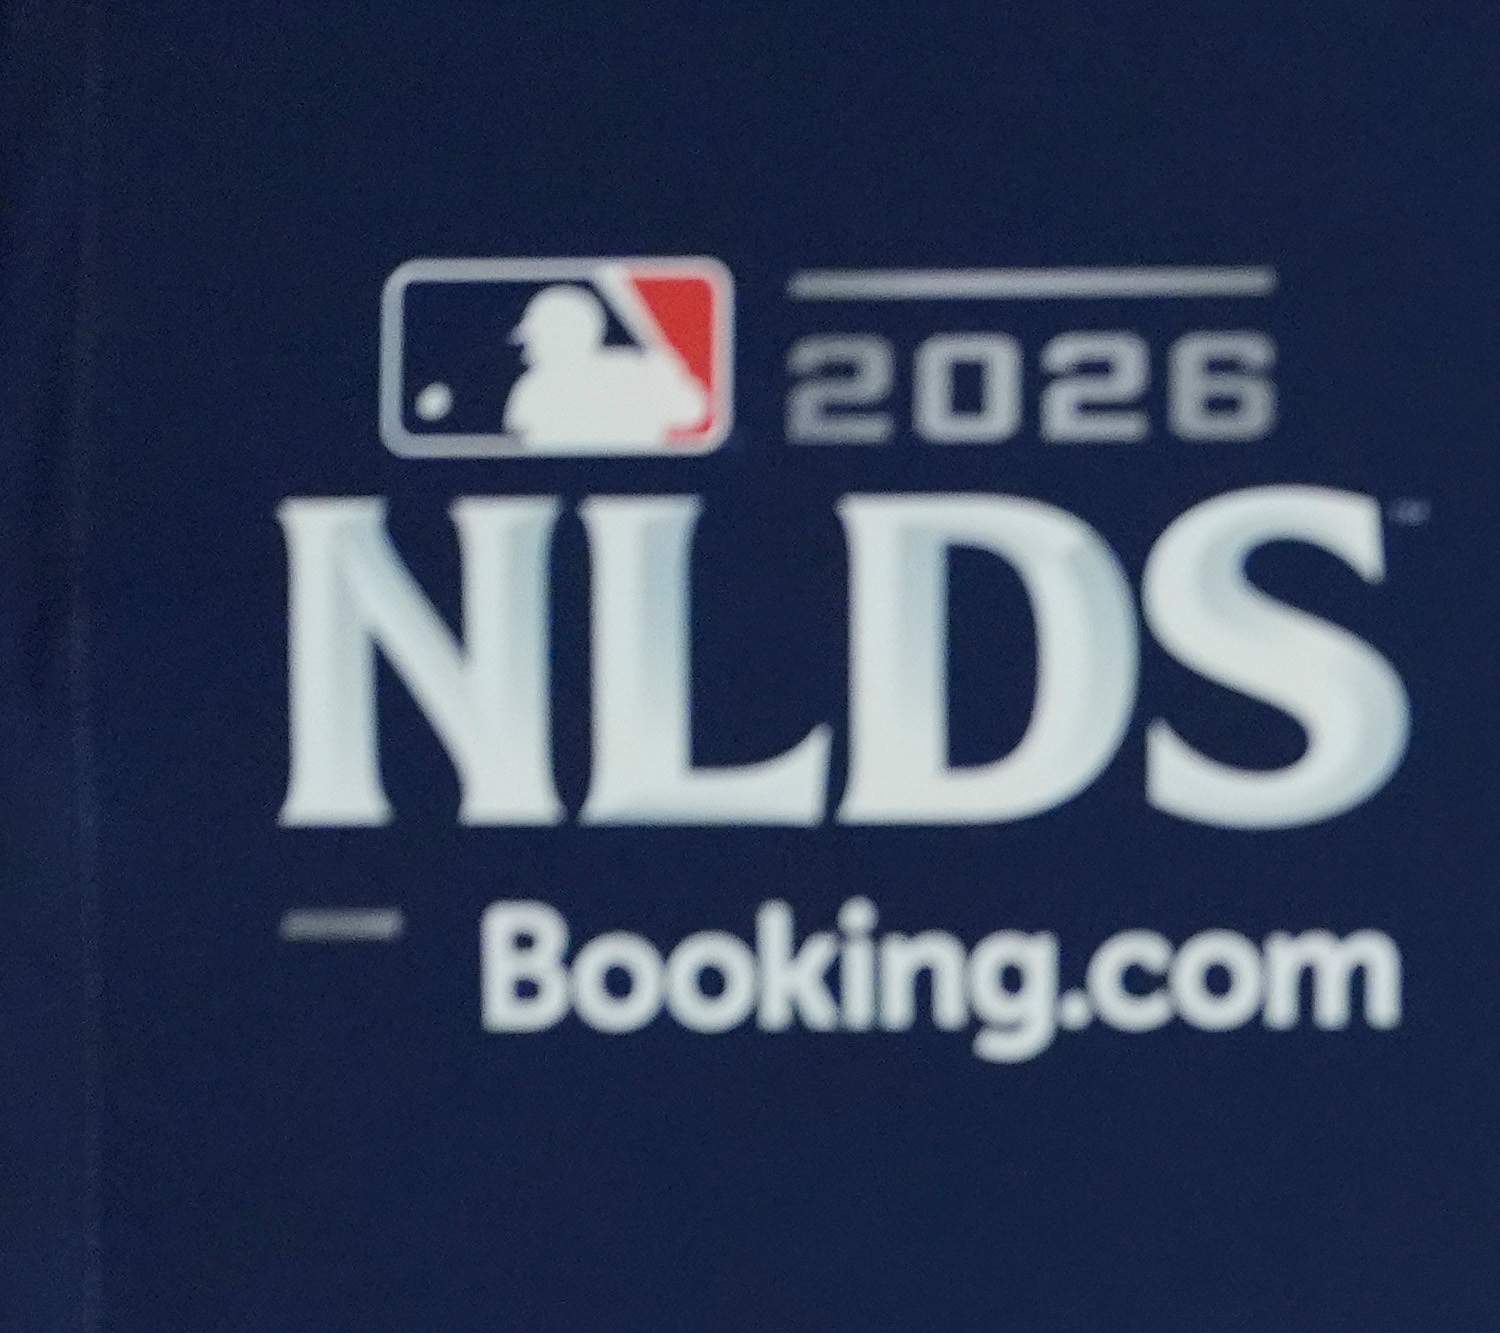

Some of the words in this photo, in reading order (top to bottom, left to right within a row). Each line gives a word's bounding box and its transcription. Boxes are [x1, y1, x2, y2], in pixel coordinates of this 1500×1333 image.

[788, 331, 1276, 444] 2026
[277, 484, 1411, 829] NLDS
[480, 896, 1402, 1064] Booking.com
